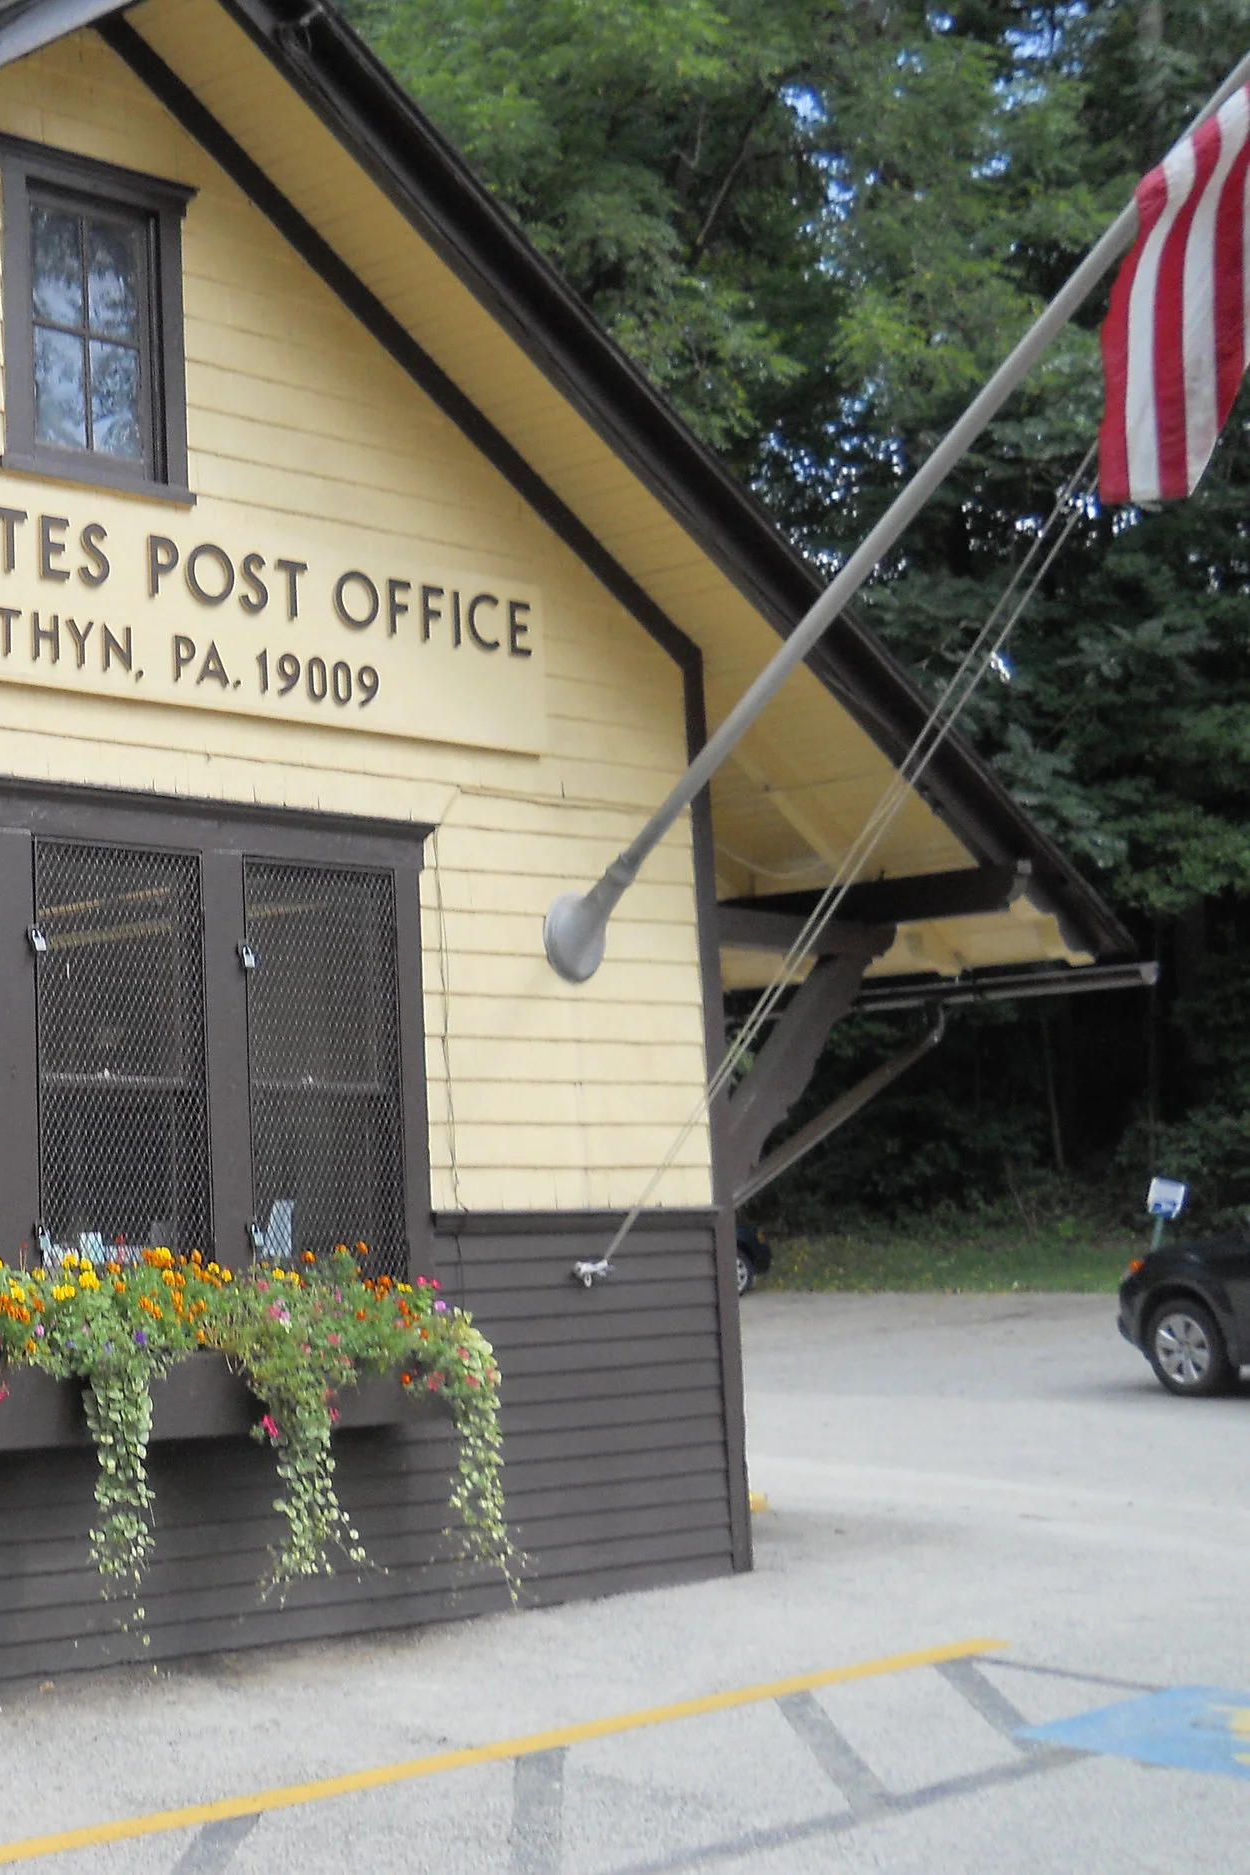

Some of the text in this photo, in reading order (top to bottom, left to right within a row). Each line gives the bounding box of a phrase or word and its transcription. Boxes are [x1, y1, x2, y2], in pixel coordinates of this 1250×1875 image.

[147, 534, 308, 621] POST
[334, 570, 533, 657] OFFICE
[173, 635, 241, 690] PA.
[256, 647, 380, 708] 19009
